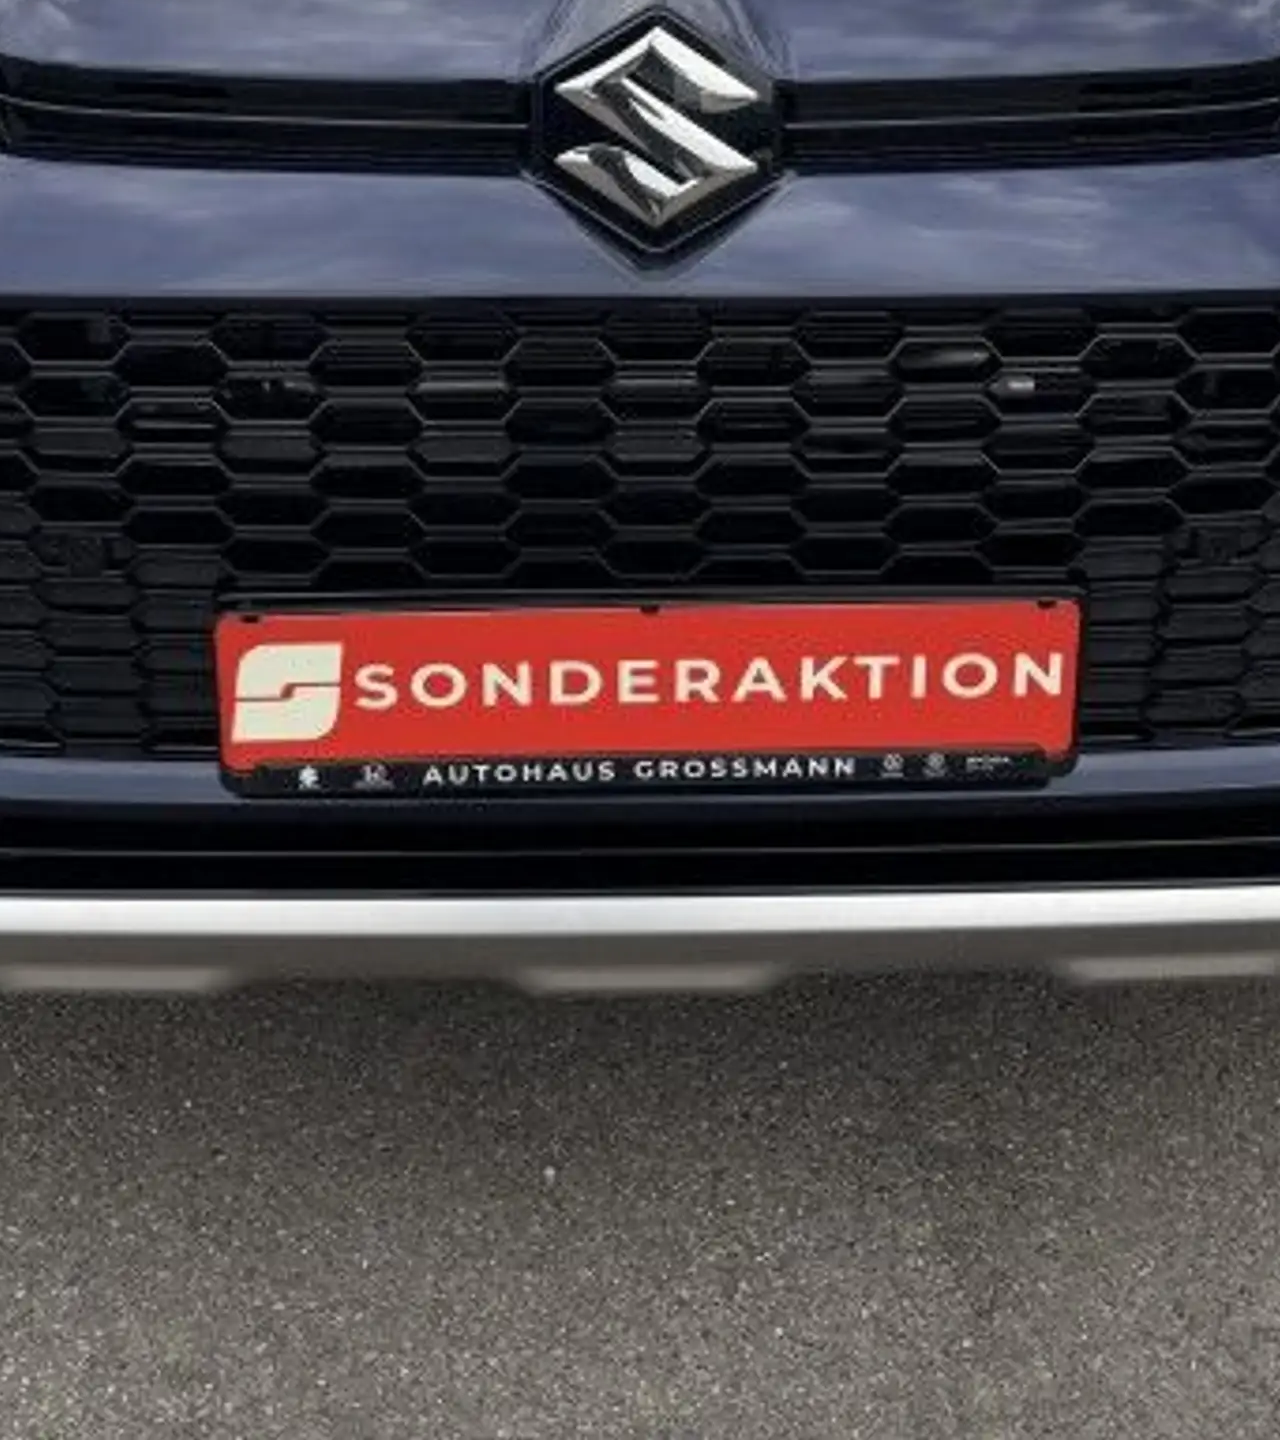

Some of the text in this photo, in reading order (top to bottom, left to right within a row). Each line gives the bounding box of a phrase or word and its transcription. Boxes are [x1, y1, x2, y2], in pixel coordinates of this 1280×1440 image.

[354, 652, 1063, 711] SONDERAKTION
[422, 760, 616, 787] AUTOHAUS
[632, 757, 856, 780] GROSSMANN
